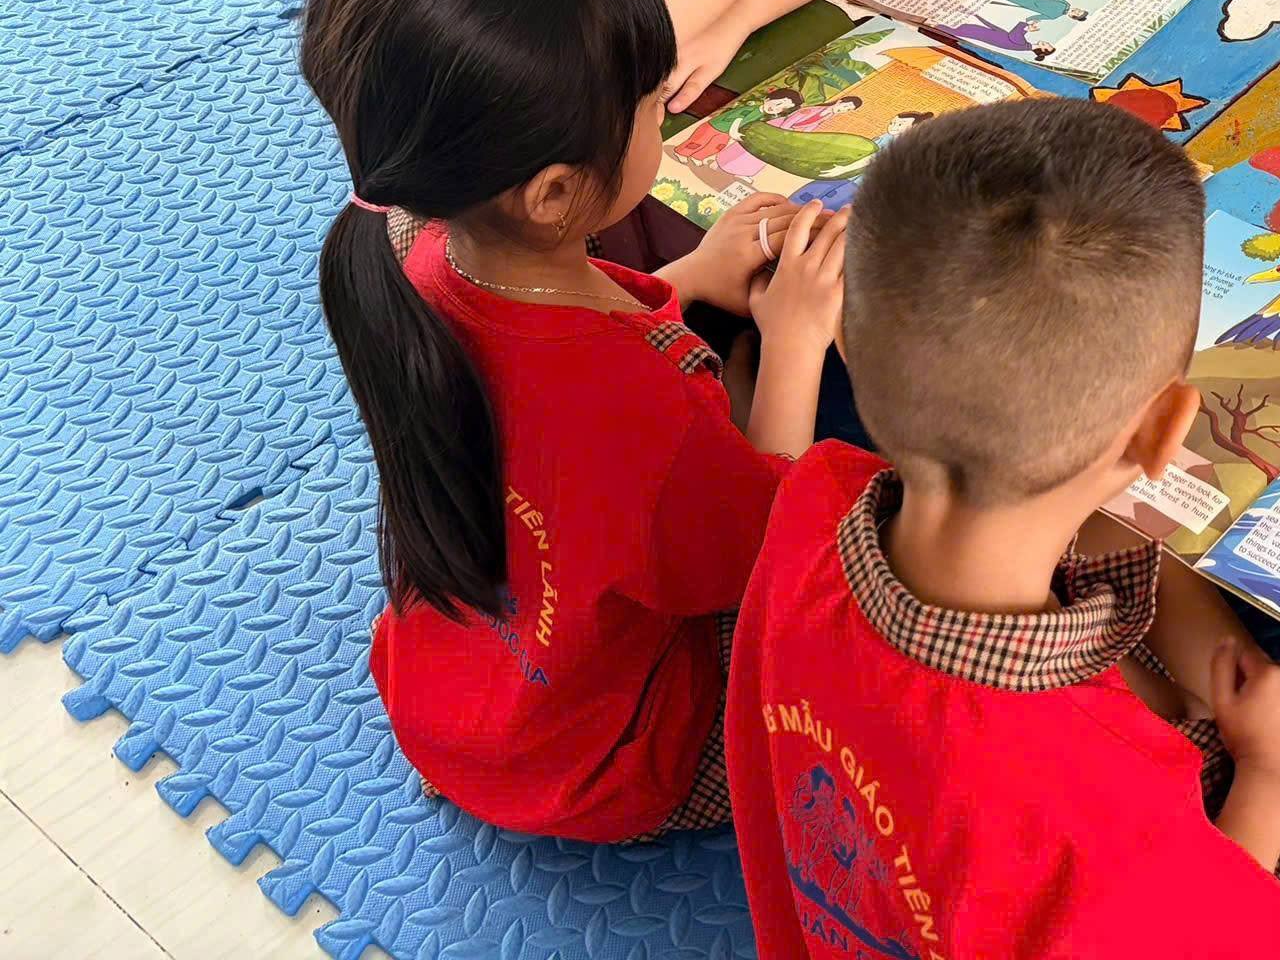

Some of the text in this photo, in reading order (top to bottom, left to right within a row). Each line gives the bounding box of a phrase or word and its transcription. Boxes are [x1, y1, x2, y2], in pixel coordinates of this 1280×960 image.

[1145, 479, 1157, 490] the
[1159, 488, 1179, 503] forest
[1181, 501, 1189, 509] to
[1191, 506, 1208, 520] hunt
[1168, 472, 1188, 484] eager
[1196, 485, 1211, 498] look
[1211, 494, 1222, 504] for
[505, 486, 549, 550] TIÊN
[1259, 521, 1272, 532] the
[1265, 515, 1278, 524] sea
[1252, 529, 1268, 540] find
[1238, 545, 1247, 553] to
[1247, 551, 1277, 569] succeed
[1245, 537, 1267, 552] things
[1267, 549, 1276, 557] to
[894, 844, 938, 941] TIÊN
